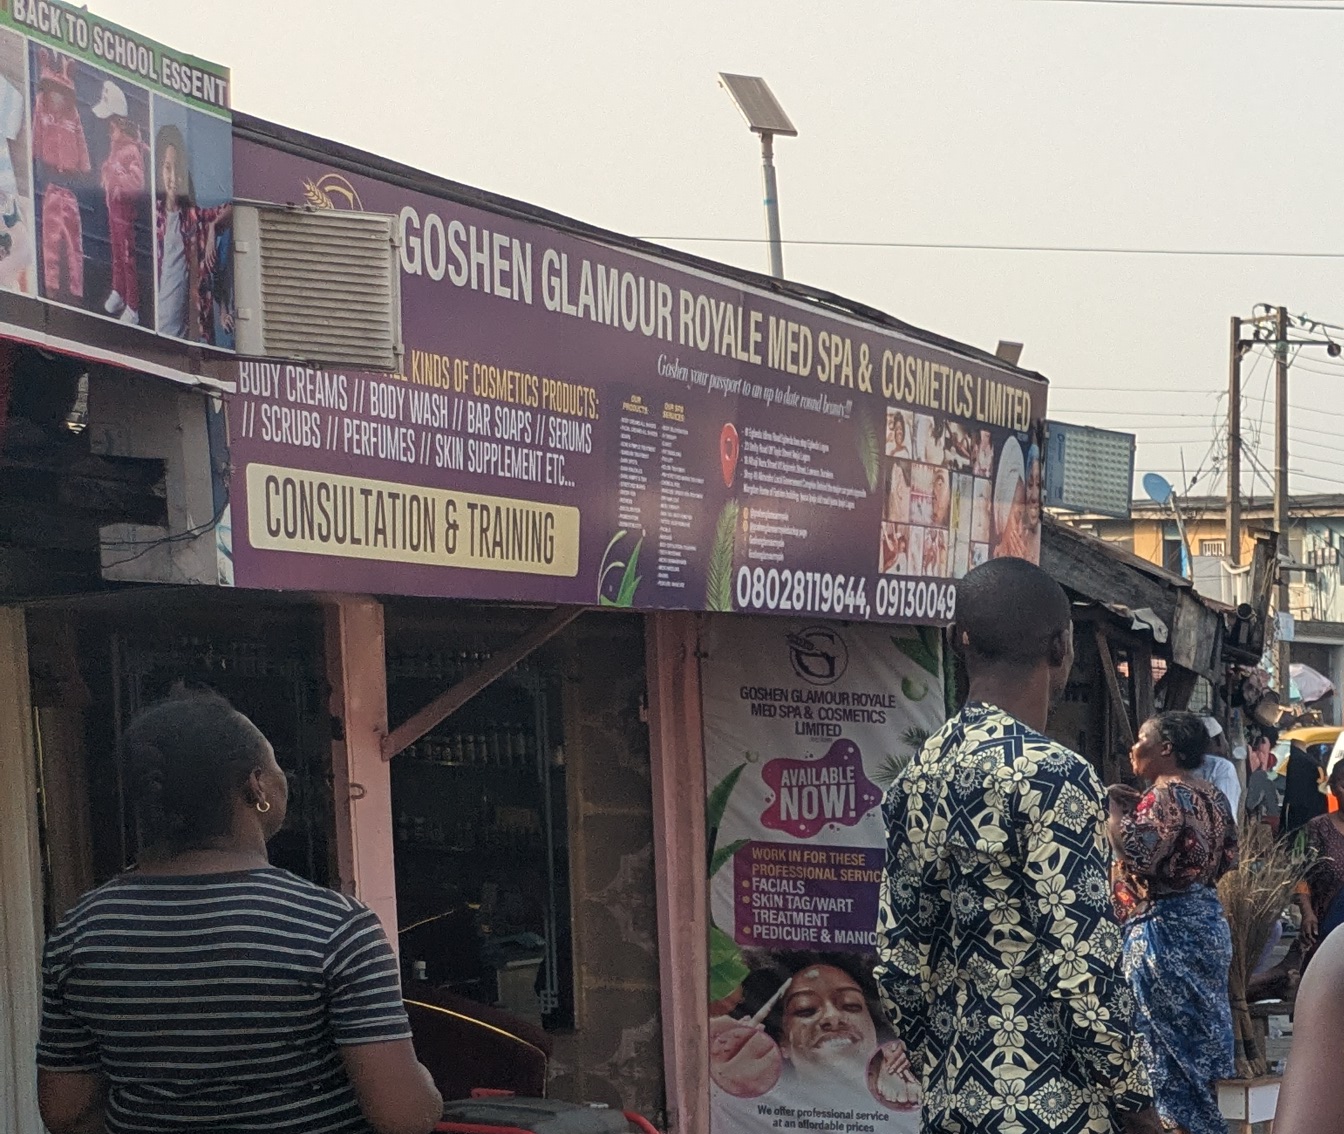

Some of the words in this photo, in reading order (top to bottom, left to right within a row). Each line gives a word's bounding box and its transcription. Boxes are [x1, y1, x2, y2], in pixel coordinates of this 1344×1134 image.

[12, 0, 63, 39] BACK
[65, 13, 89, 50] TO
[92, 25, 158, 80] SCHOOL
[161, 55, 228, 108] ESSENT
[400, 205, 533, 305] GOSHEN
[541, 248, 673, 342] GLAMOUR
[679, 288, 763, 366] ROYALE
[768, 315, 813, 378] MED
[817, 331, 854, 390] SPA
[858, 342, 873, 395] &
[881, 350, 974, 418] COSMETICS
[976, 375, 1031, 433] LIMITED
[411, 349, 450, 390] KINDS
[453, 358, 469, 394] OF
[473, 363, 539, 409] COSMETICS
[542, 378, 600, 420] PRODUCTS:
[657, 353, 689, 382] Goshen
[687, 368, 710, 391] your
[709, 374, 742, 398] passport
[239, 361, 281, 400] BODY
[286, 365, 348, 412] CREAMS
[353, 378, 364, 414] //
[370, 381, 408, 422] BODY
[409, 389, 448, 430] WASH
[452, 397, 463, 432] //
[467, 400, 491, 436] BAR
[494, 405, 532, 445] SOAPS
[535, 414, 546, 446] //
[548, 416, 592, 455] SERUMS
[260, 402, 321, 449] SCRUBS
[326, 413, 338, 451] //
[343, 417, 416, 463] PERFUMES
[419, 431, 432, 466] //
[435, 433, 464, 471] SKIN
[467, 438, 543, 483] SUPPLEMENT
[545, 452, 576, 487] ETC...
[265, 474, 436, 554] CONSULTATION
[444, 498, 460, 555] &
[467, 502, 555, 565] TRAINING
[736, 565, 871, 620] 08028119644,
[875, 577, 957, 620] 09130049
[740, 686, 789, 701] GOSHEN
[791, 688, 852, 706] GLAMOUR
[853, 692, 896, 708] ROYALE
[751, 702, 777, 718] MED
[779, 704, 802, 719] SPA
[804, 705, 813, 720] &
[818, 707, 887, 724] COSMETICS
[795, 722, 842, 737] LIMITED
[781, 766, 856, 787] AVAILABLE
[780, 784, 856, 821] NOW!
[752, 847, 786, 862] WORK
[788, 851, 801, 862] IN
[804, 851, 827, 864] FOR
[829, 852, 866, 866] THESE
[752, 863, 838, 881] PROFESSIONAL
[752, 877, 806, 894] FACIALS
[752, 892, 784, 909] SKIN
[786, 895, 854, 913] TAG/WART
[752, 909, 830, 927] TREATMENT
[753, 925, 818, 942] PEDICURE
[820, 929, 831, 943] &
[757, 1104, 772, 1115] We
[774, 1106, 795, 1117] offer
[797, 1107, 854, 1120] professional
[855, 1110, 889, 1122] service
[772, 1118, 783, 1128] at
[784, 1121, 796, 1129] an
[798, 1119, 844, 1131] affordable
[846, 1122, 875, 1133] prices
